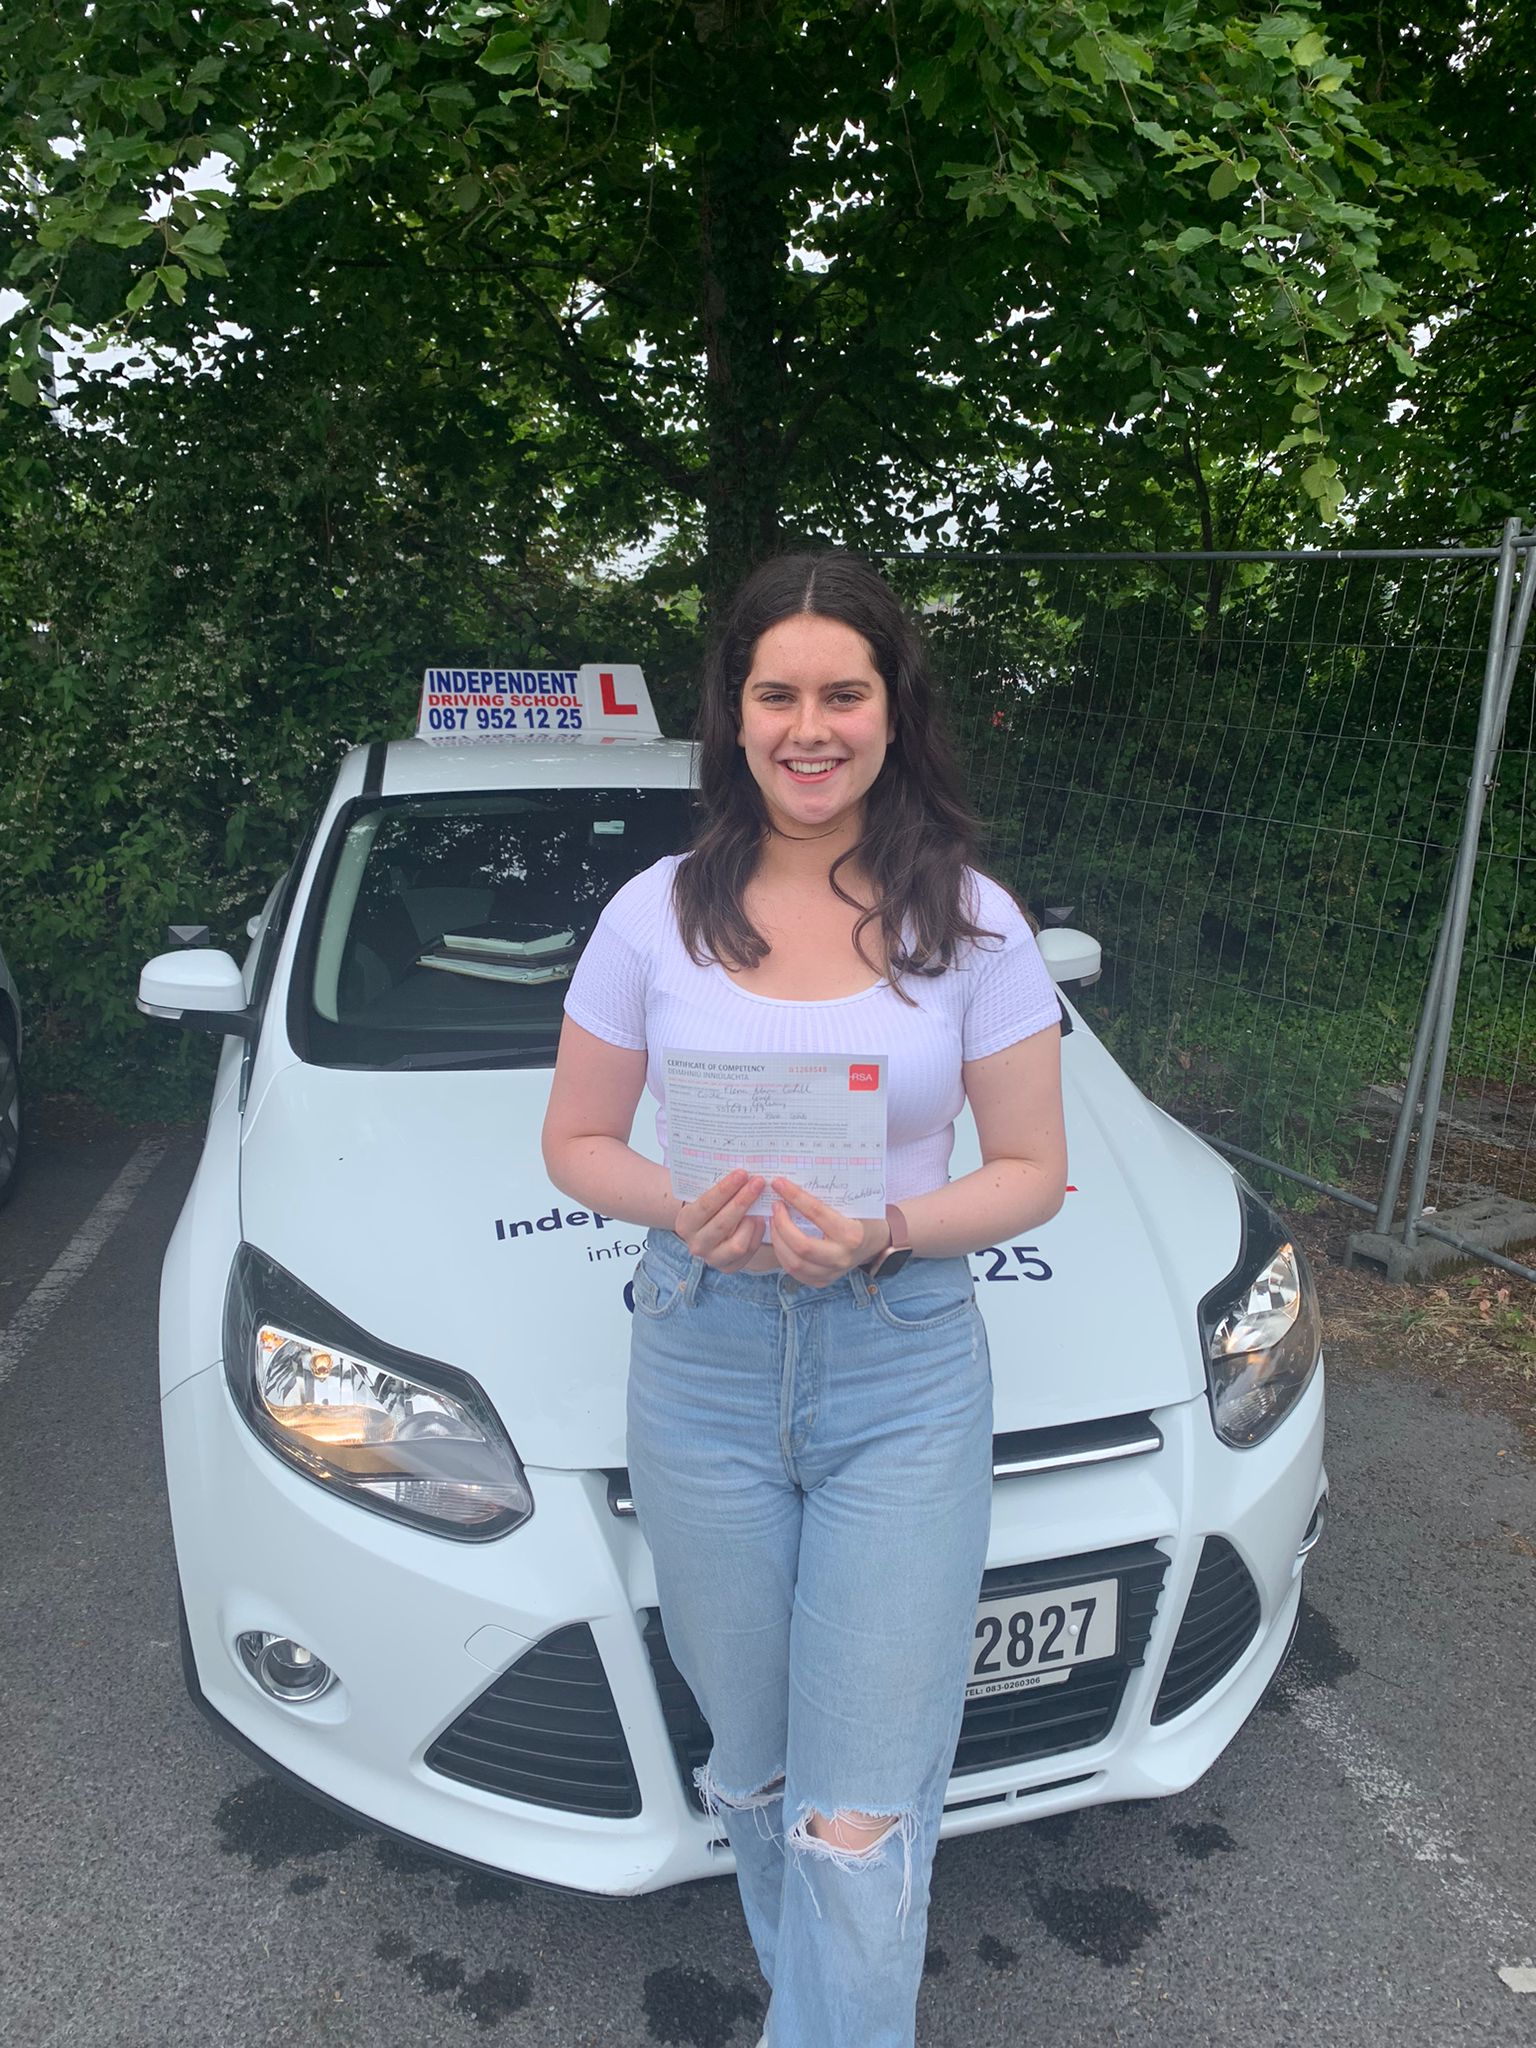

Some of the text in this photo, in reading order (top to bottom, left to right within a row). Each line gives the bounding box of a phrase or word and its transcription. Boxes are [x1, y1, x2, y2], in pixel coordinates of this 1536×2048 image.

[428, 670, 578, 694] INDEPENDENT
[428, 694, 583, 707] DRIVING SCHOOL
[599, 673, 638, 715] L
[429, 708, 583, 730] 087 952 12 25
[667, 1059, 705, 1070] CERTIFICATE
[718, 1064, 765, 1073] COMPETENCY
[851, 1072, 873, 1081] RSA
[587, 1240, 650, 1261] info
[974, 1597, 1097, 1674] 2827
